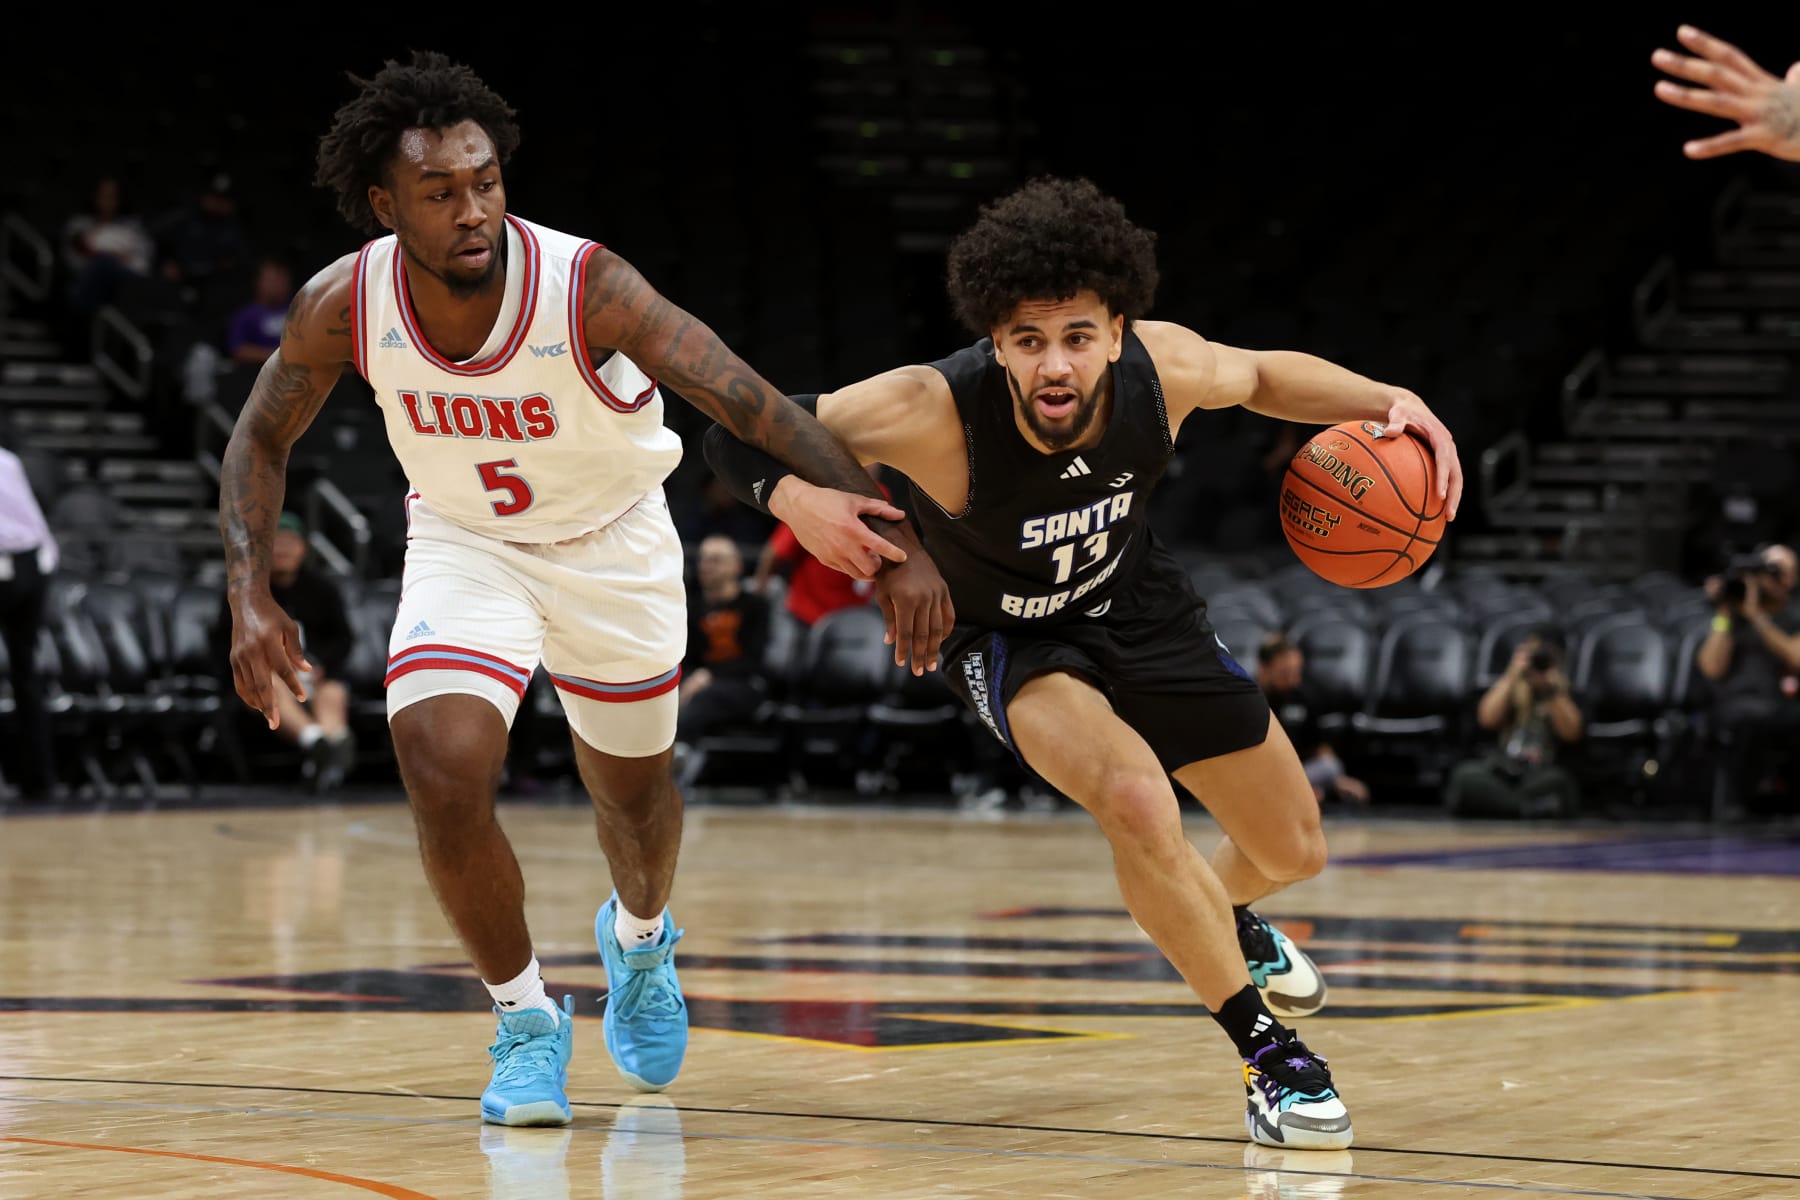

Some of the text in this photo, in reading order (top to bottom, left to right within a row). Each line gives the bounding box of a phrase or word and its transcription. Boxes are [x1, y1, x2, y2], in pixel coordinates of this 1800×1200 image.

[378, 339, 407, 349] adidas
[527, 341, 568, 358] WCC
[397, 390, 559, 443] LIONS
[474, 457, 534, 518] 5
[1296, 441, 1376, 503] PALDING
[1020, 489, 1136, 551] SANTA
[1051, 530, 1110, 585] 13
